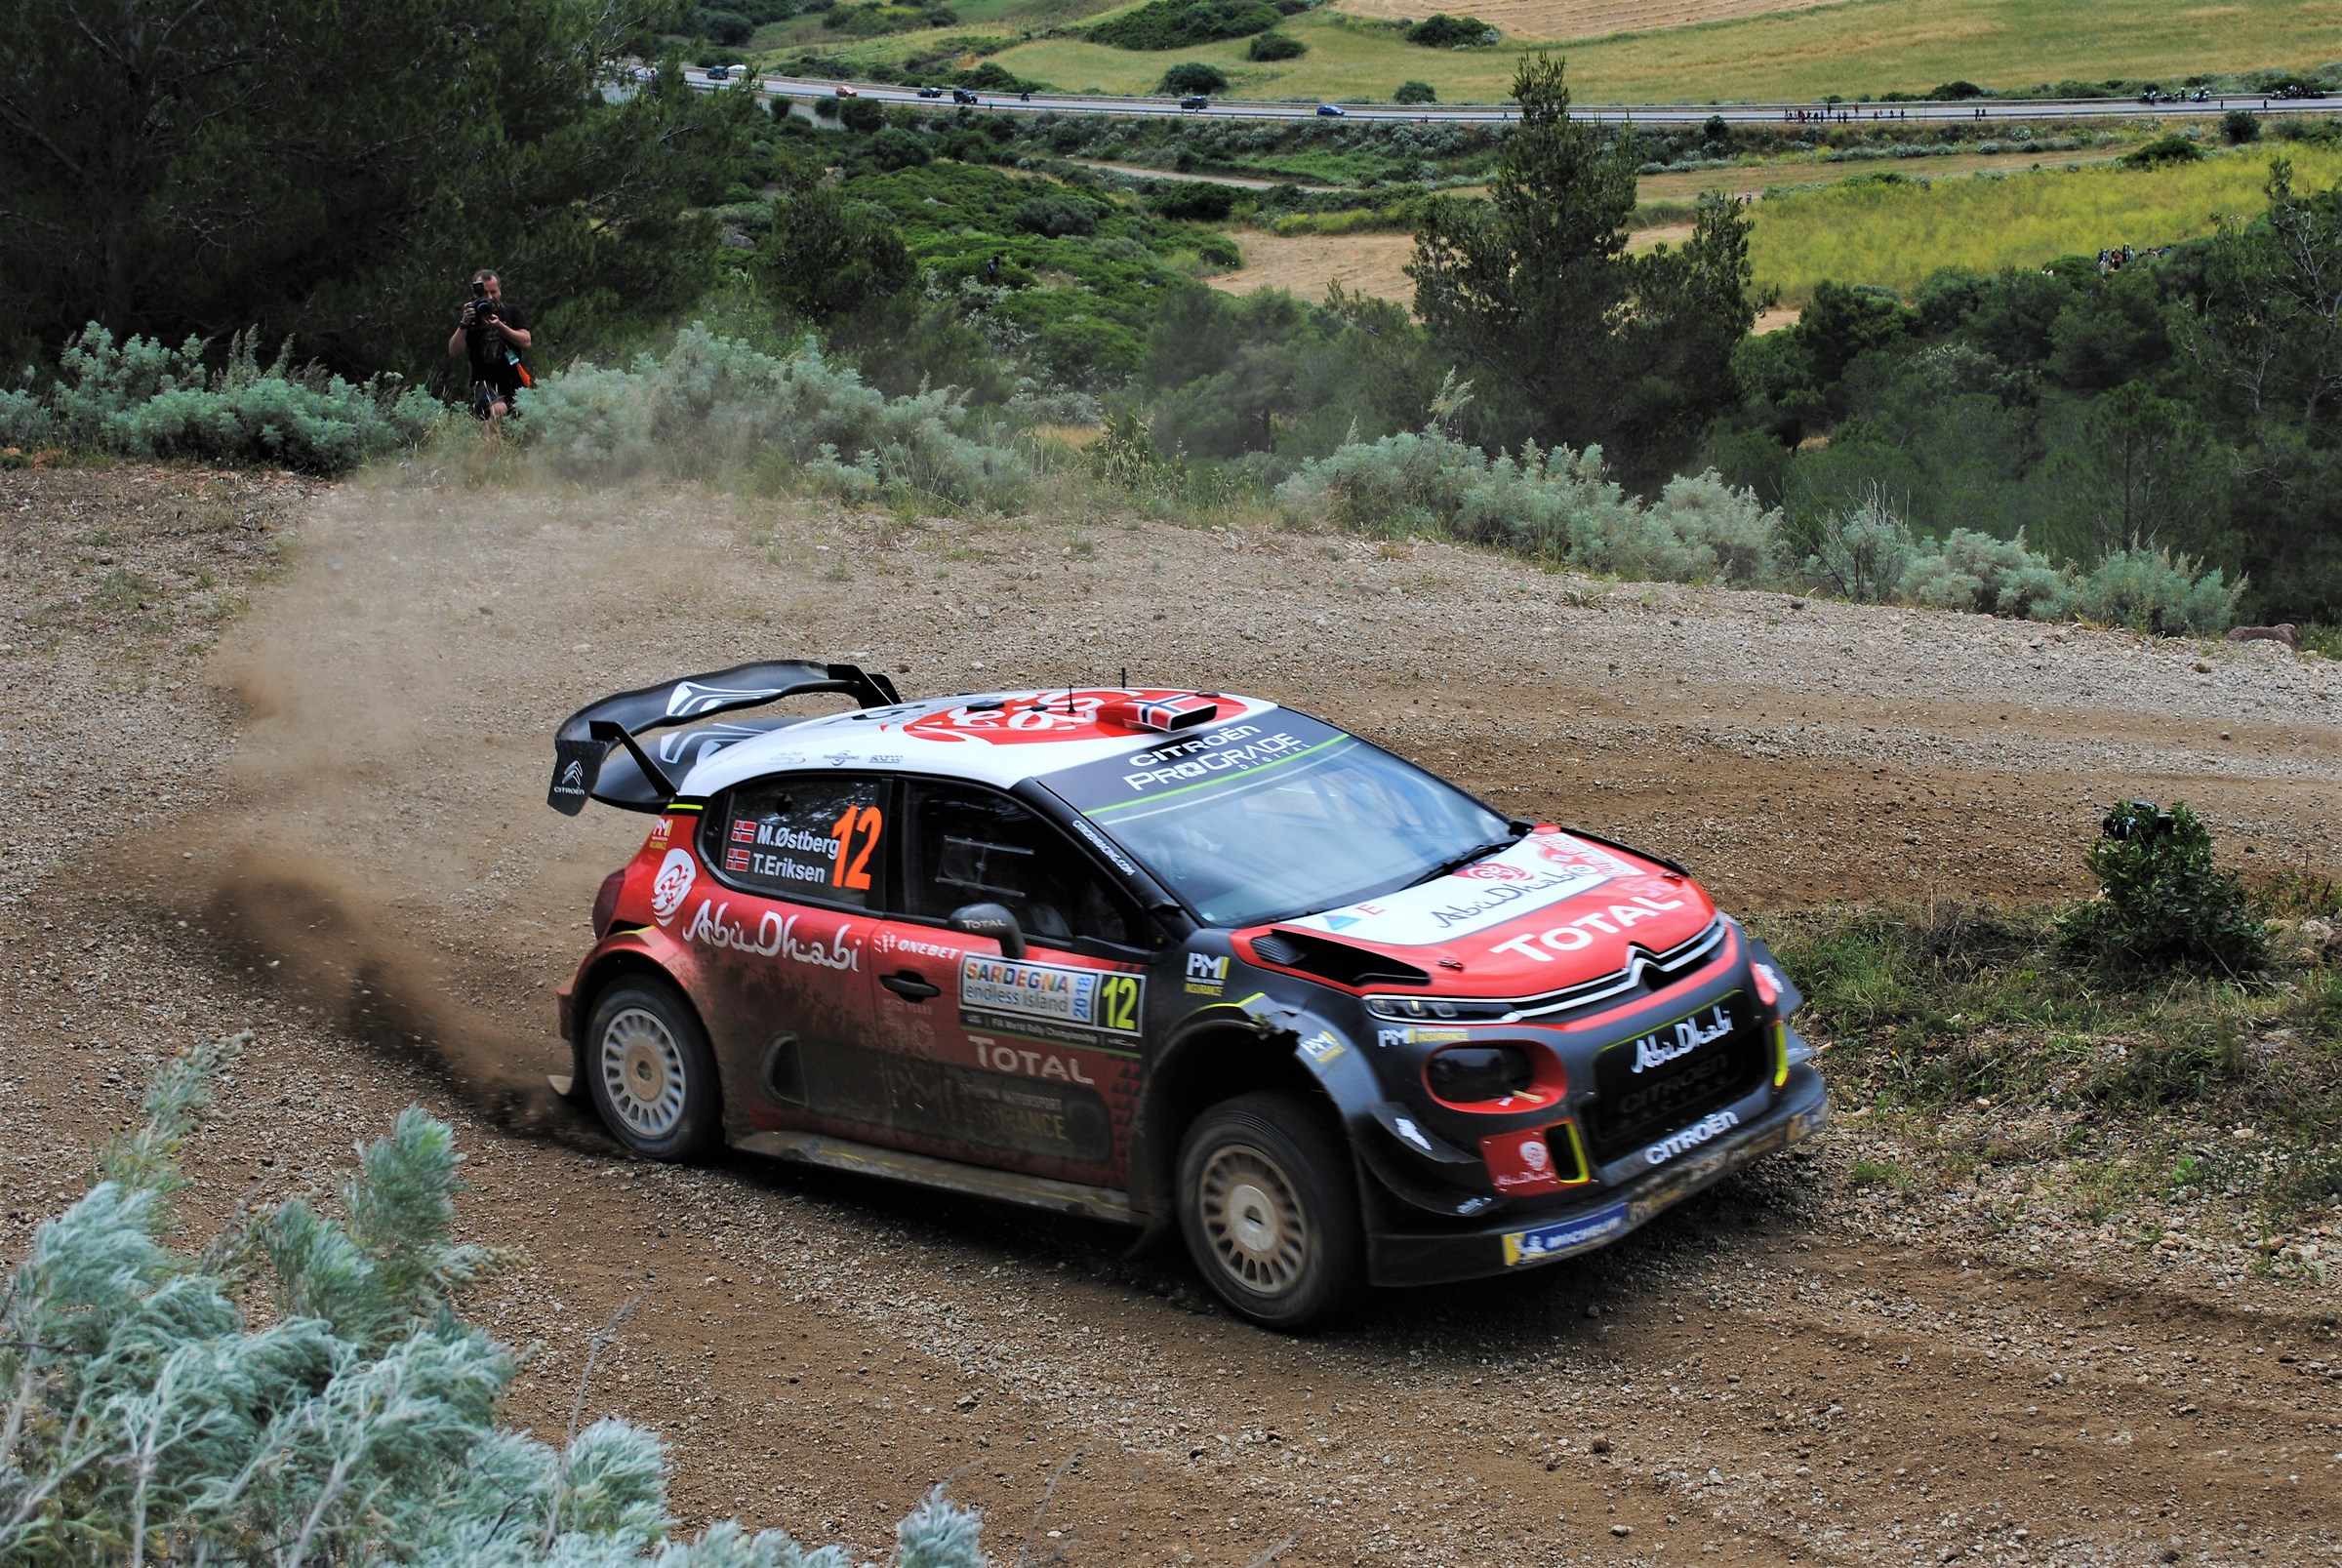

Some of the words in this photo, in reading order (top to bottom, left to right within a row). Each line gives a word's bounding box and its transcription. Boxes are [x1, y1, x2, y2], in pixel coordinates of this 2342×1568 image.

[1122, 732, 1303, 791] PROGRADE
[1128, 725, 1262, 767] CITROËN
[1239, 744, 1312, 771] DIGITAL
[756, 824, 841, 861] M.Østberg
[831, 804, 883, 891] 12
[752, 853, 826, 884] T.Eriksen
[962, 918, 1006, 930] TOTAL
[1489, 895, 1686, 963] TOTAL
[898, 939, 961, 960] ONEBET
[965, 961, 1070, 994] SARDEGNA
[1073, 977, 1091, 1020] 2018
[965, 984, 1021, 1007] endless
[1023, 988, 1070, 1014] island
[1102, 977, 1138, 1030] 12
[967, 1034, 1095, 1085] TOTAL
[1644, 1110, 1740, 1165] CITROËN
